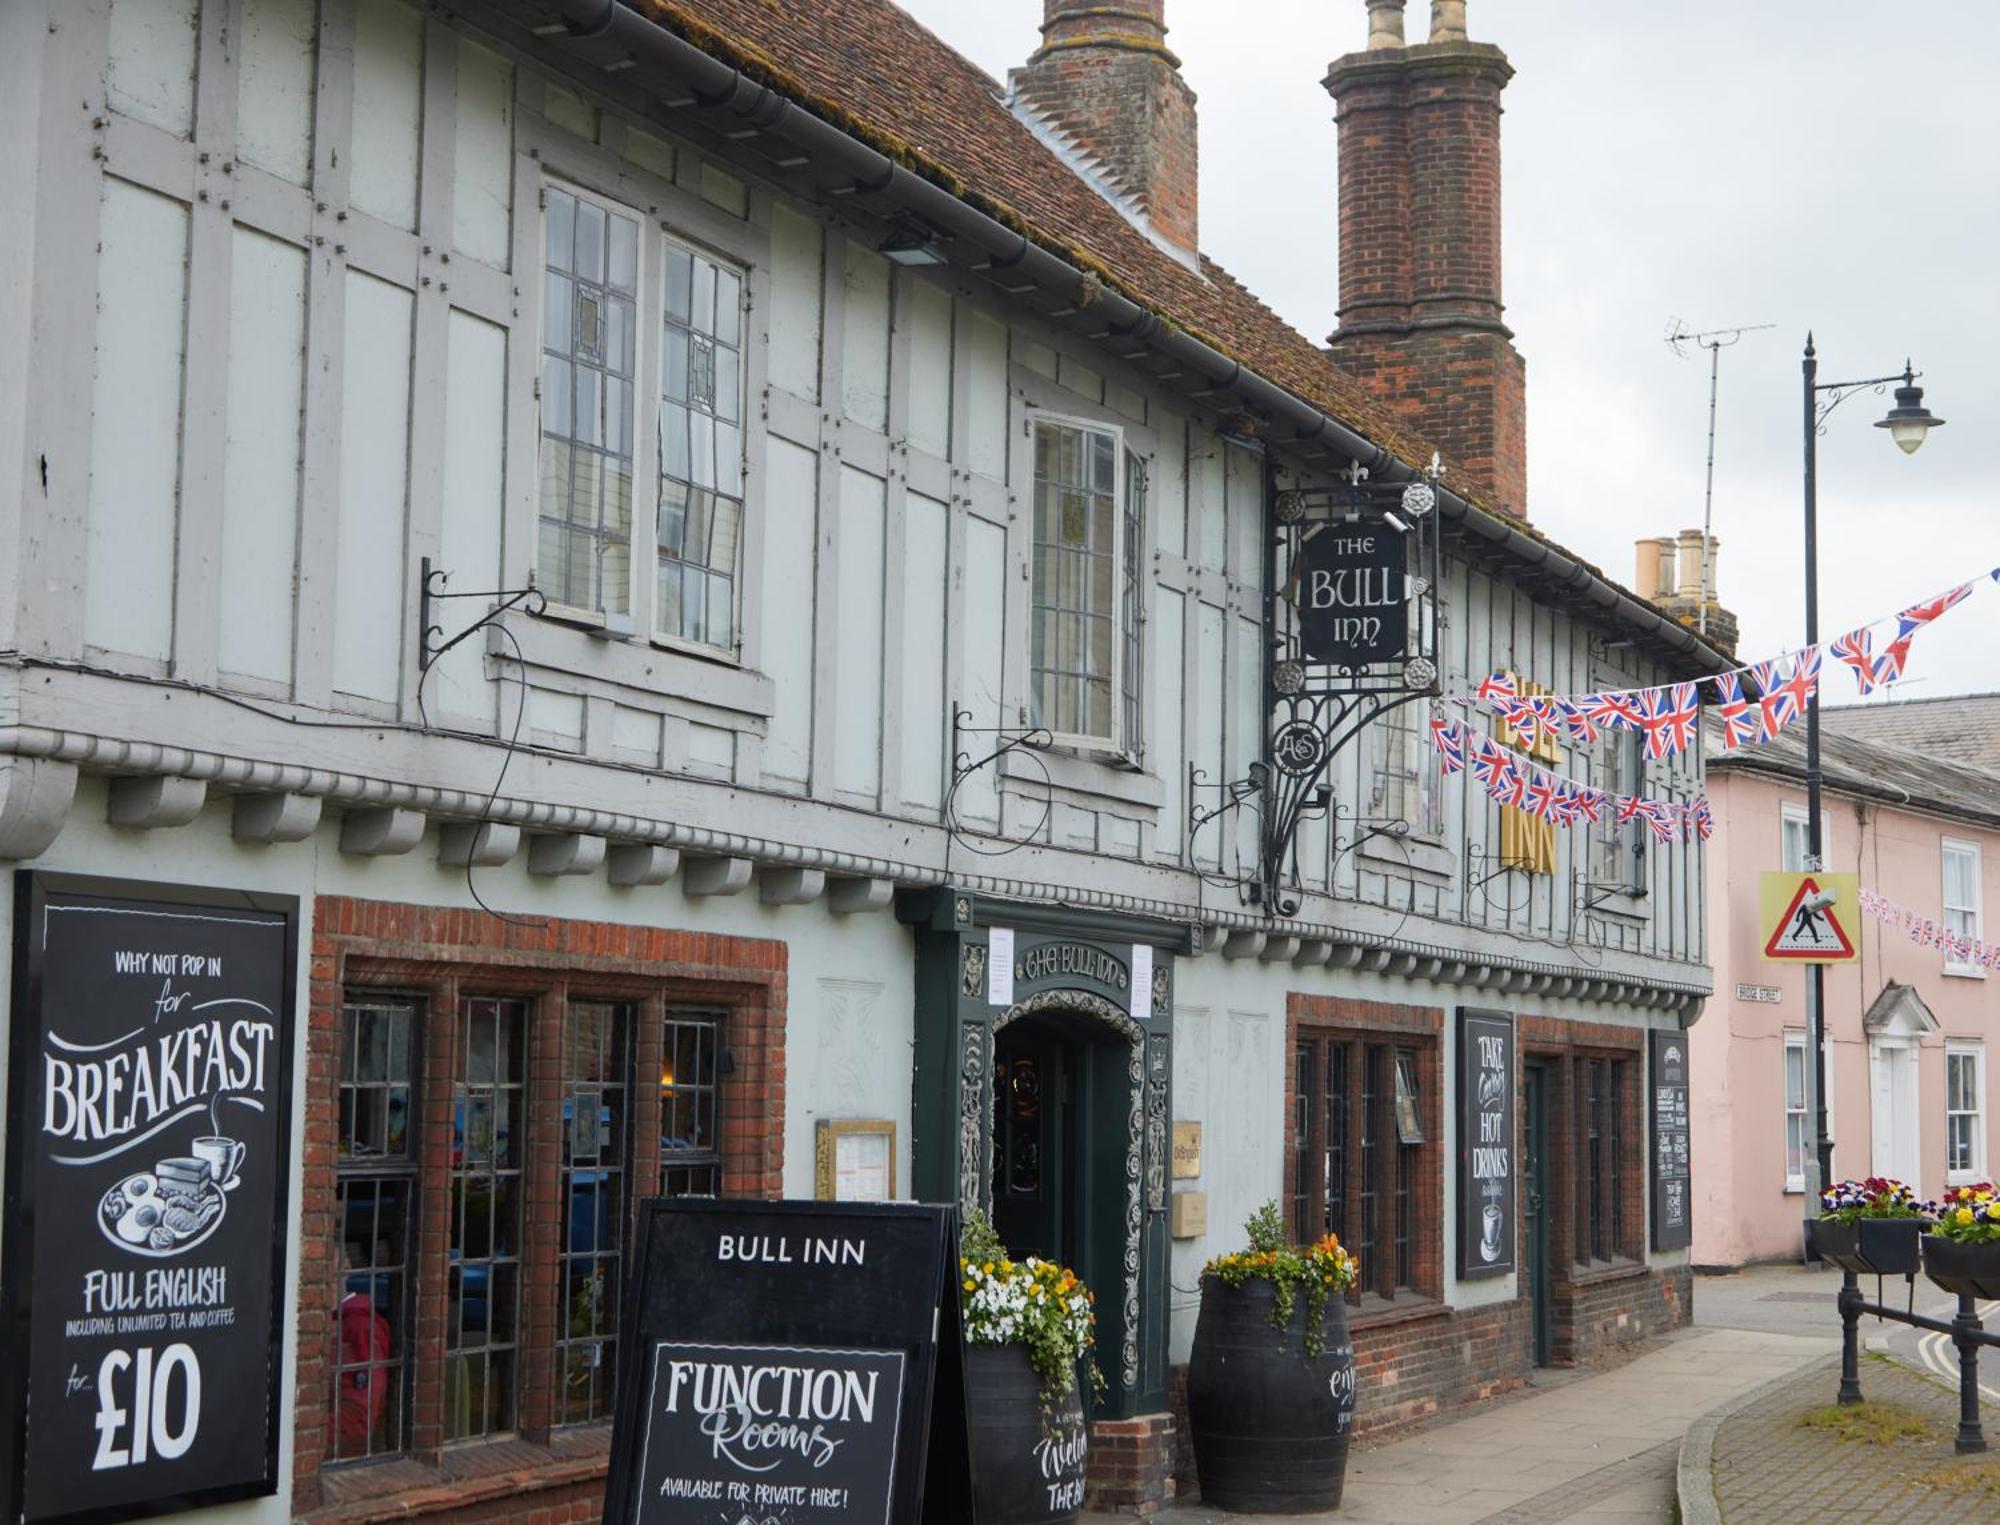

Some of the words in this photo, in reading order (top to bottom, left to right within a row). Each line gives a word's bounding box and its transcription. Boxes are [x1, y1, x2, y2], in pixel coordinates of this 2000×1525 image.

[1334, 537, 1375, 555] THE
[1311, 567, 1399, 608] BULL
[1333, 616, 1381, 648] INN
[1280, 733, 1315, 760] A&S
[1500, 803, 1555, 876] INN
[116, 951, 150, 974] WHY
[153, 953, 178, 975] NOT
[181, 955, 205, 976] POP
[208, 957, 221, 977] IN
[1061, 946, 1093, 975] BULL
[155, 978, 191, 1023] for
[1478, 1036, 1504, 1070] TAKE
[43, 1020, 273, 1141] BREAKFAST
[1480, 1112, 1503, 1142] HOT
[1473, 1148, 1508, 1178] DRINKS
[718, 1235, 792, 1262] BULL
[803, 1238, 865, 1265] INN
[84, 1270, 142, 1314] FULL
[145, 1266, 226, 1308] ENGLISH
[66, 1319, 114, 1337] INCLUDING
[117, 1316, 166, 1333] UNLIMITED
[169, 1312, 186, 1330] TEA
[189, 1311, 206, 1327] AND
[206, 1307, 235, 1326] COFFEE
[91, 1343, 201, 1471] £10
[665, 1361, 879, 1423] FUNCTION
[699, 1403, 845, 1472] Rooms
[660, 1477, 723, 1500] AVAILABLE
[728, 1482, 751, 1501] FOR
[754, 1485, 806, 1506] PRIVATE
[1047, 1483, 1073, 1512] THE
